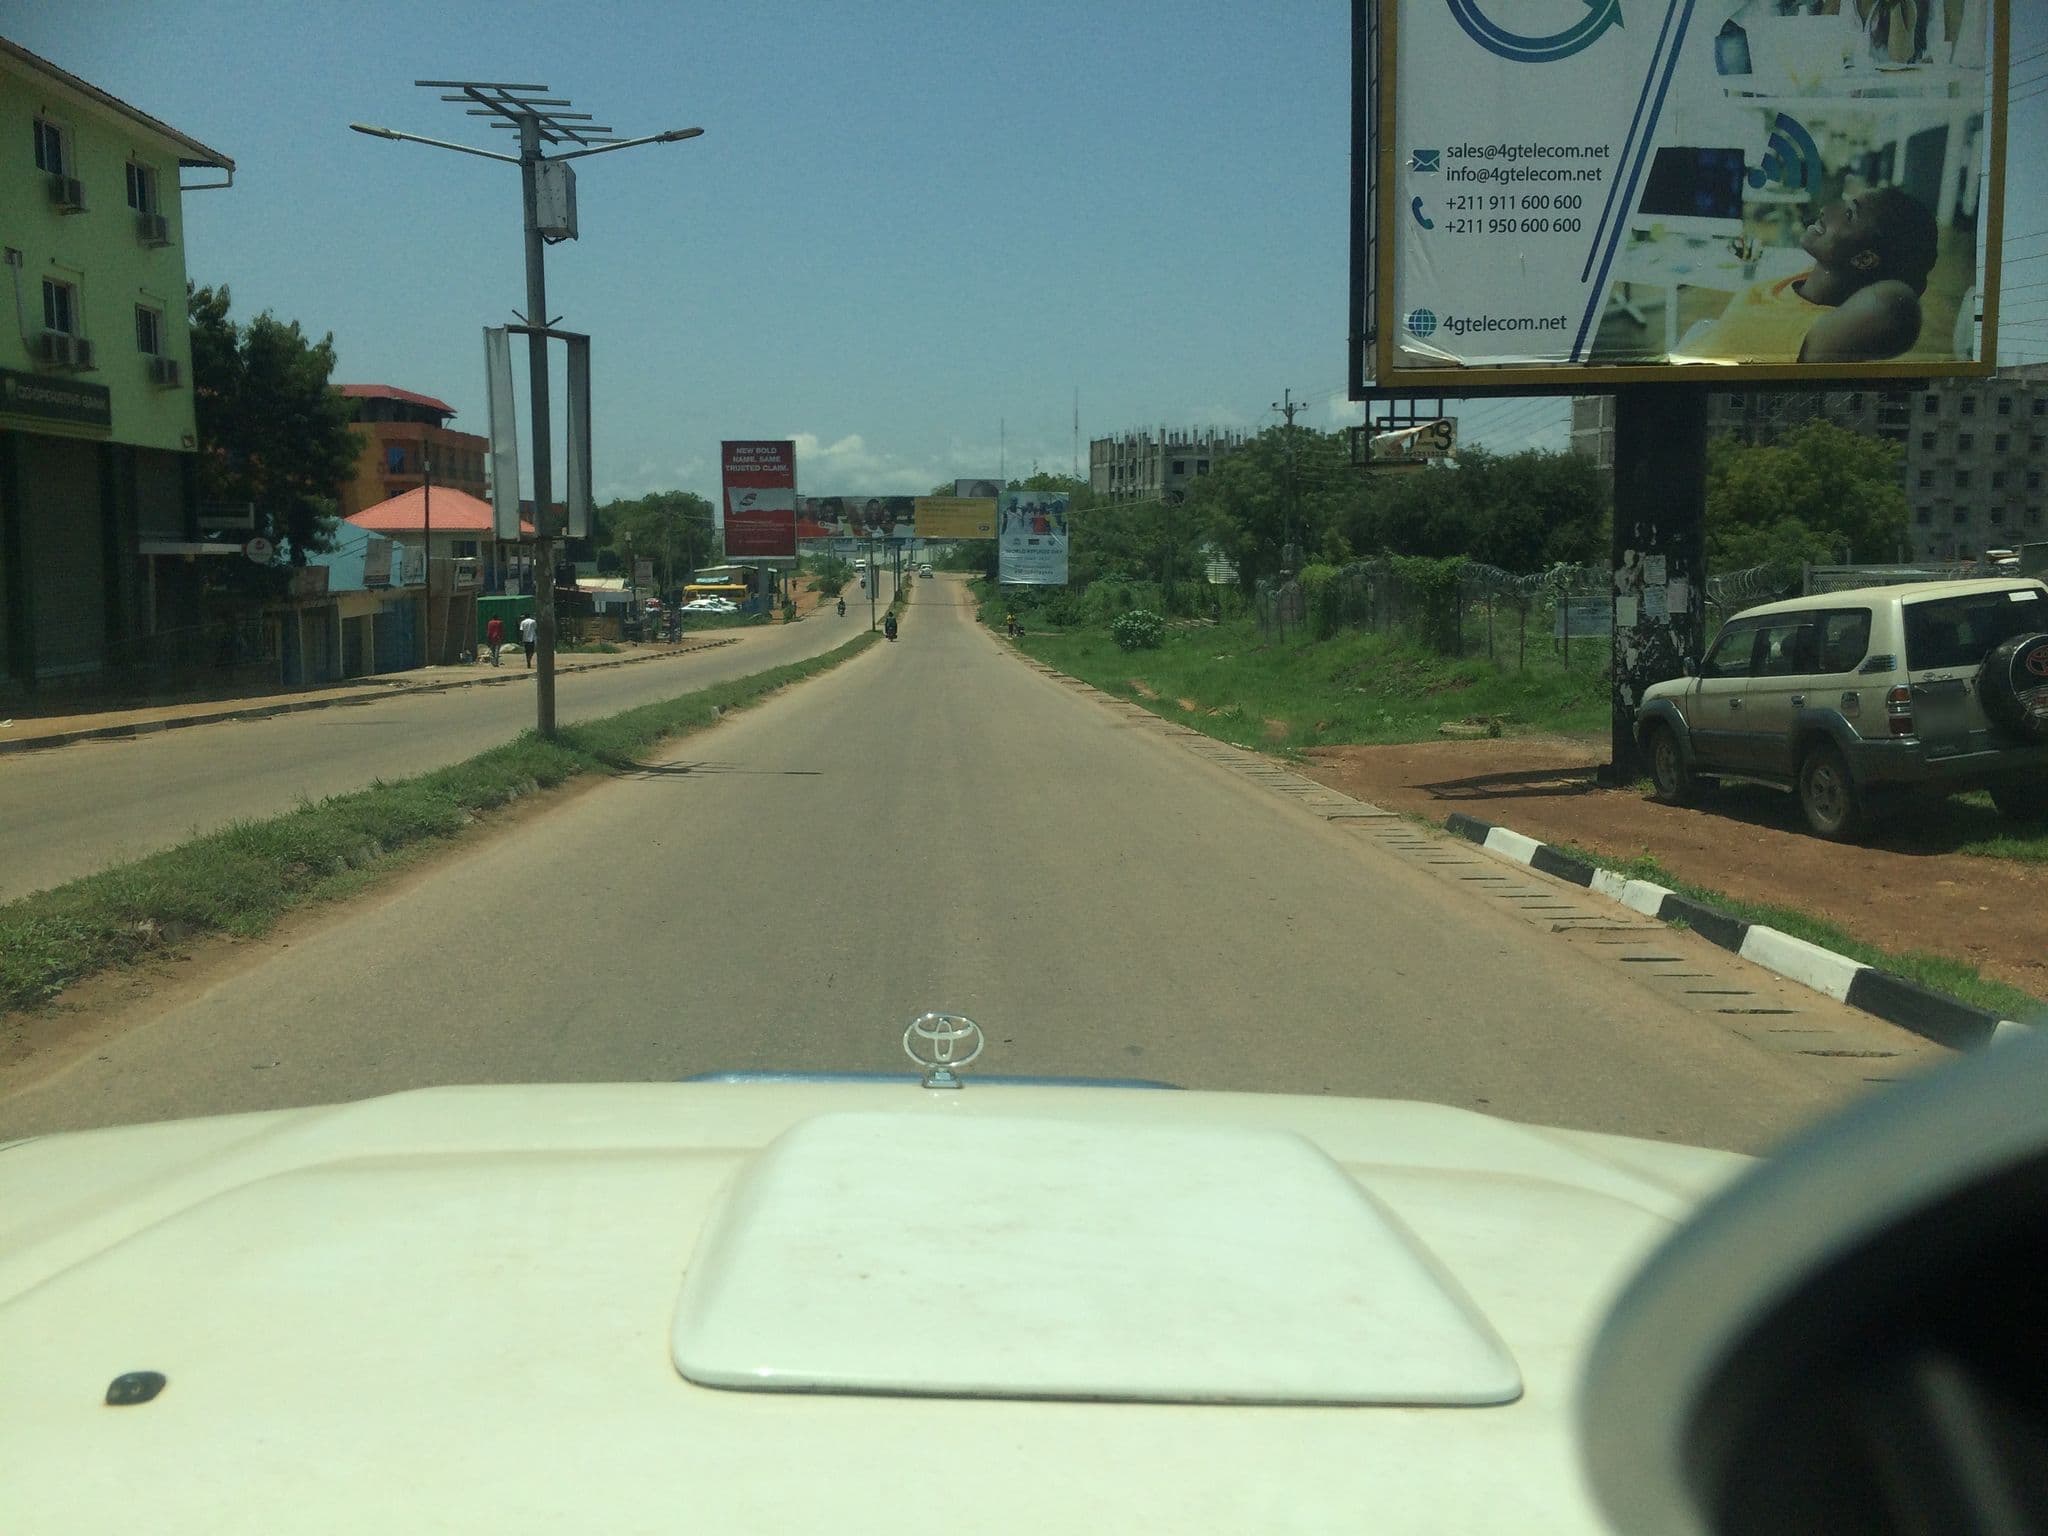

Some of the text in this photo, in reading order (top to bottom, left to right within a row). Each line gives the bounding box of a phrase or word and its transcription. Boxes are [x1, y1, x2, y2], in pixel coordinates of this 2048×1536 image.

[1447, 143, 1609, 161] sales@4gtelecom.net
[1447, 167, 1601, 184] info@4gtelecom.net
[1446, 195, 1582, 210] +211 911 600 600
[1445, 219, 1581, 234] +211 950 600 600
[1443, 315, 1567, 335] 4gtelecom.net
[726, 464, 761, 472] TRUSTED
